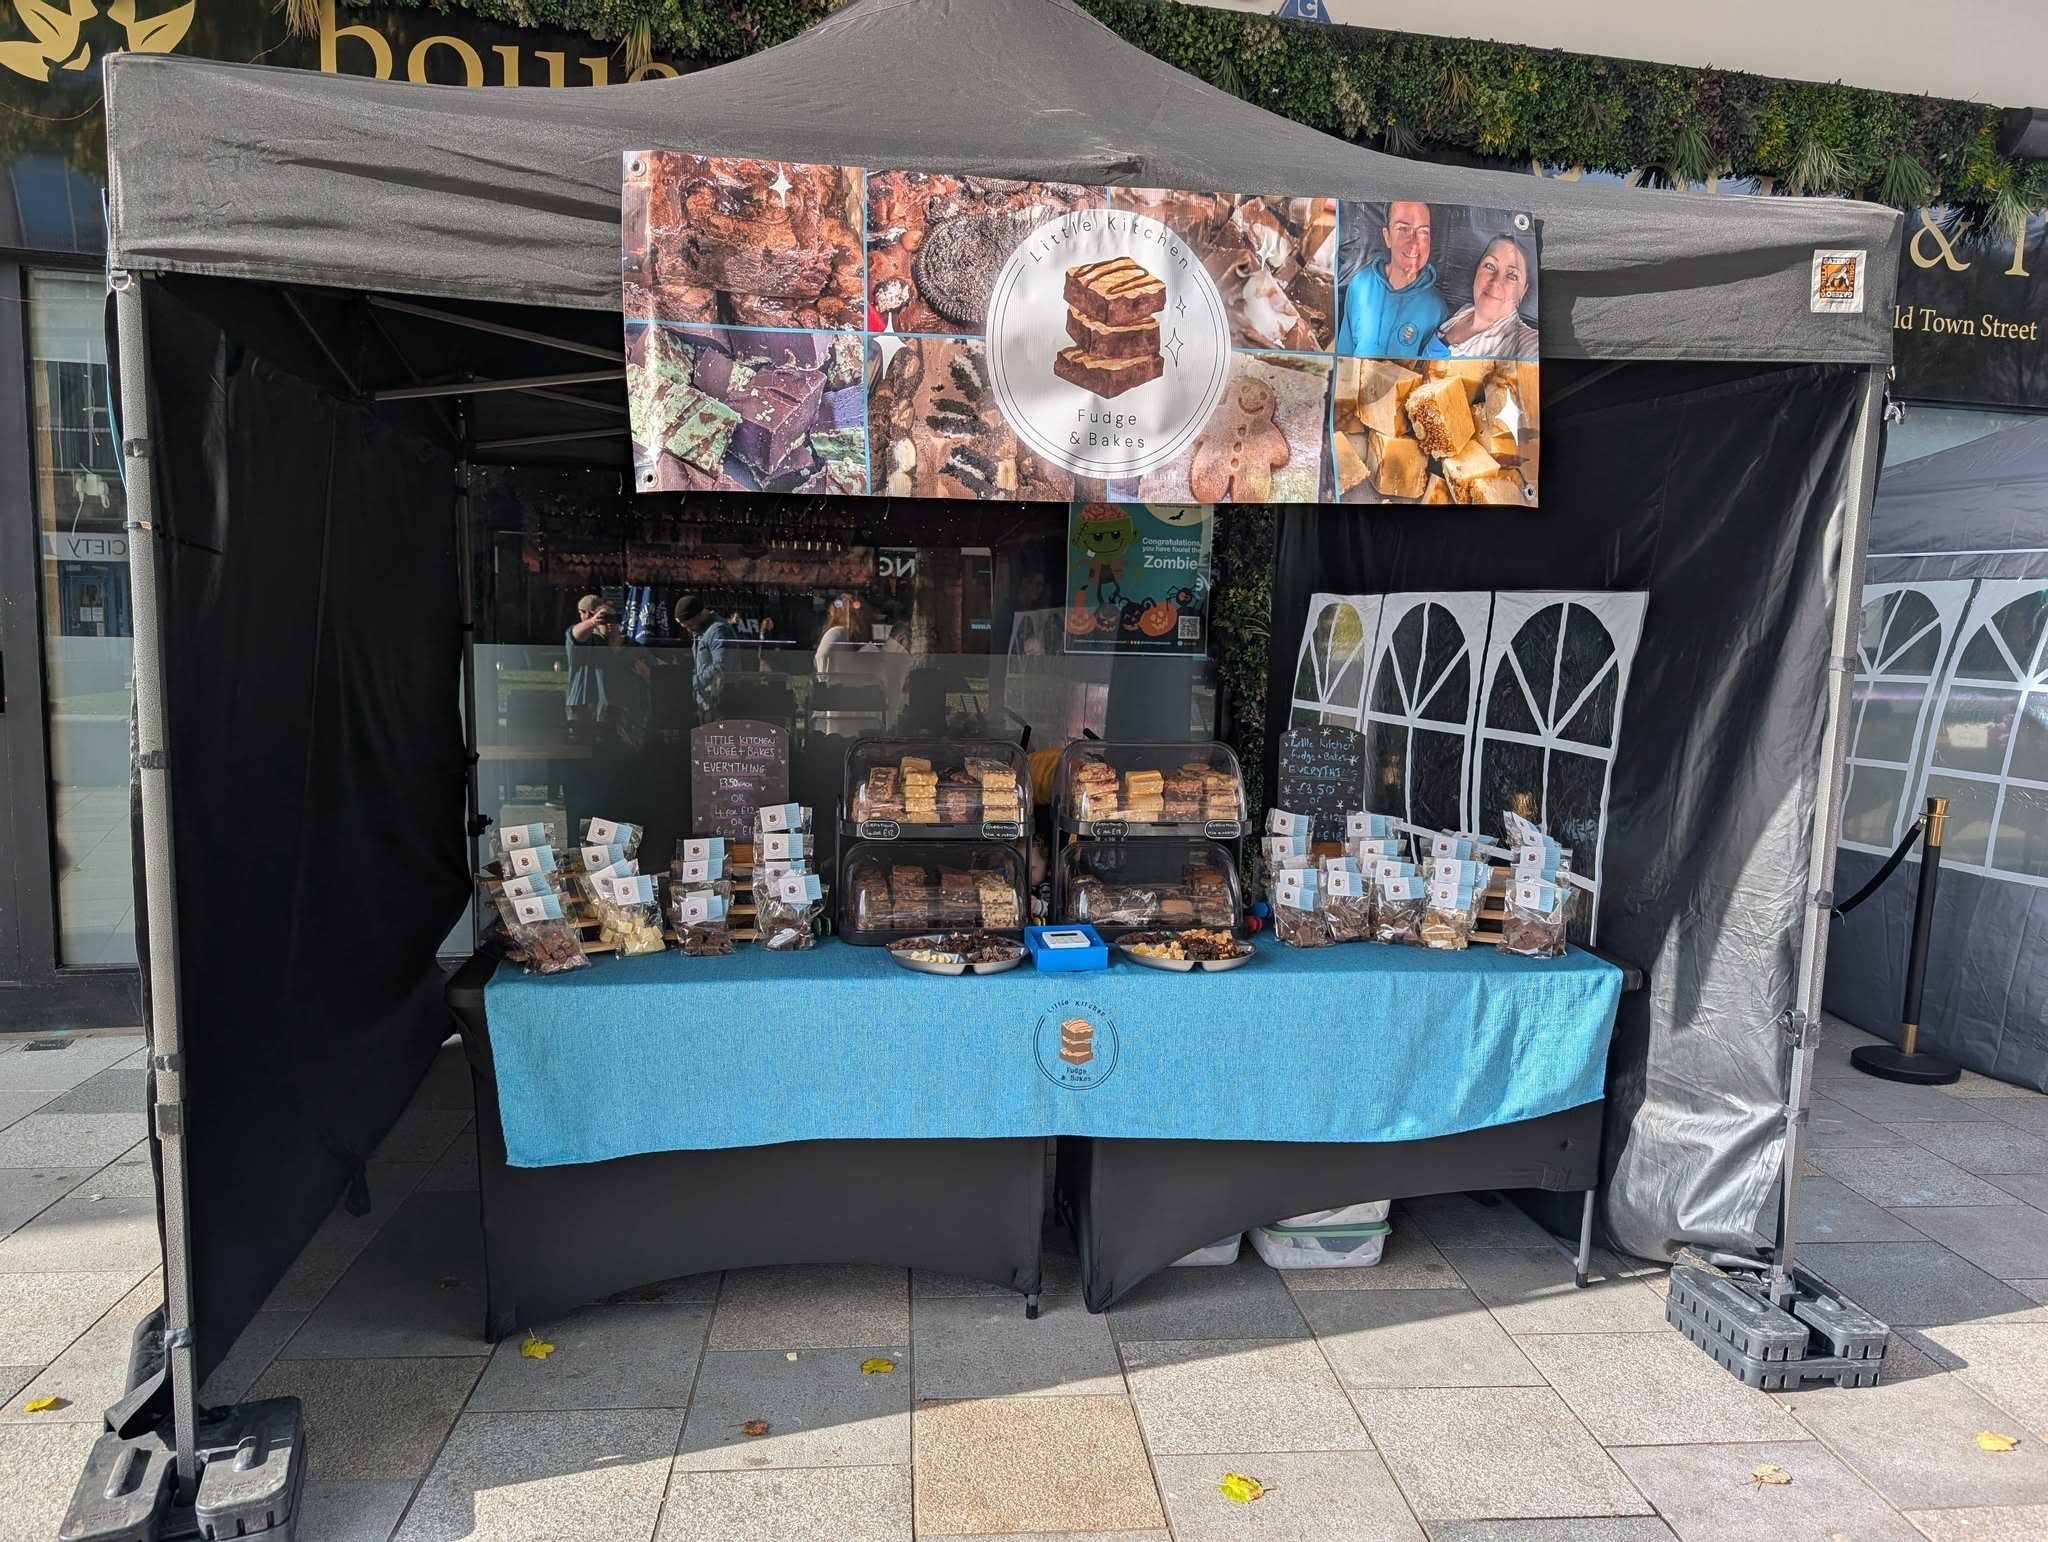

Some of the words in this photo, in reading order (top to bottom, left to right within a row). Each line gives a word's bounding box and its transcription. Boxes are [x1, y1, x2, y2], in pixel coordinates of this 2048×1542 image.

[1029, 219, 1092, 262] Little
[1107, 216, 1189, 270] Kitchen
[1919, 308, 1975, 336] Town
[1980, 313, 2038, 341] Street
[1077, 408, 1138, 429] Fudge
[1069, 431, 1081, 446] &
[1088, 432, 1145, 449] Bakes
[1156, 545, 1171, 553] have
[1143, 554, 1198, 570] Zombie
[704, 735, 735, 745] LITTLE
[707, 746, 738, 756] FUDGE
[747, 747, 775, 757] BAKES
[703, 761, 767, 774] EVERYTHING
[730, 794, 746, 803] OR
[715, 826, 722, 836] 6
[1046, 1000, 1069, 1013] Little
[1075, 1000, 1106, 1017] Kitchen
